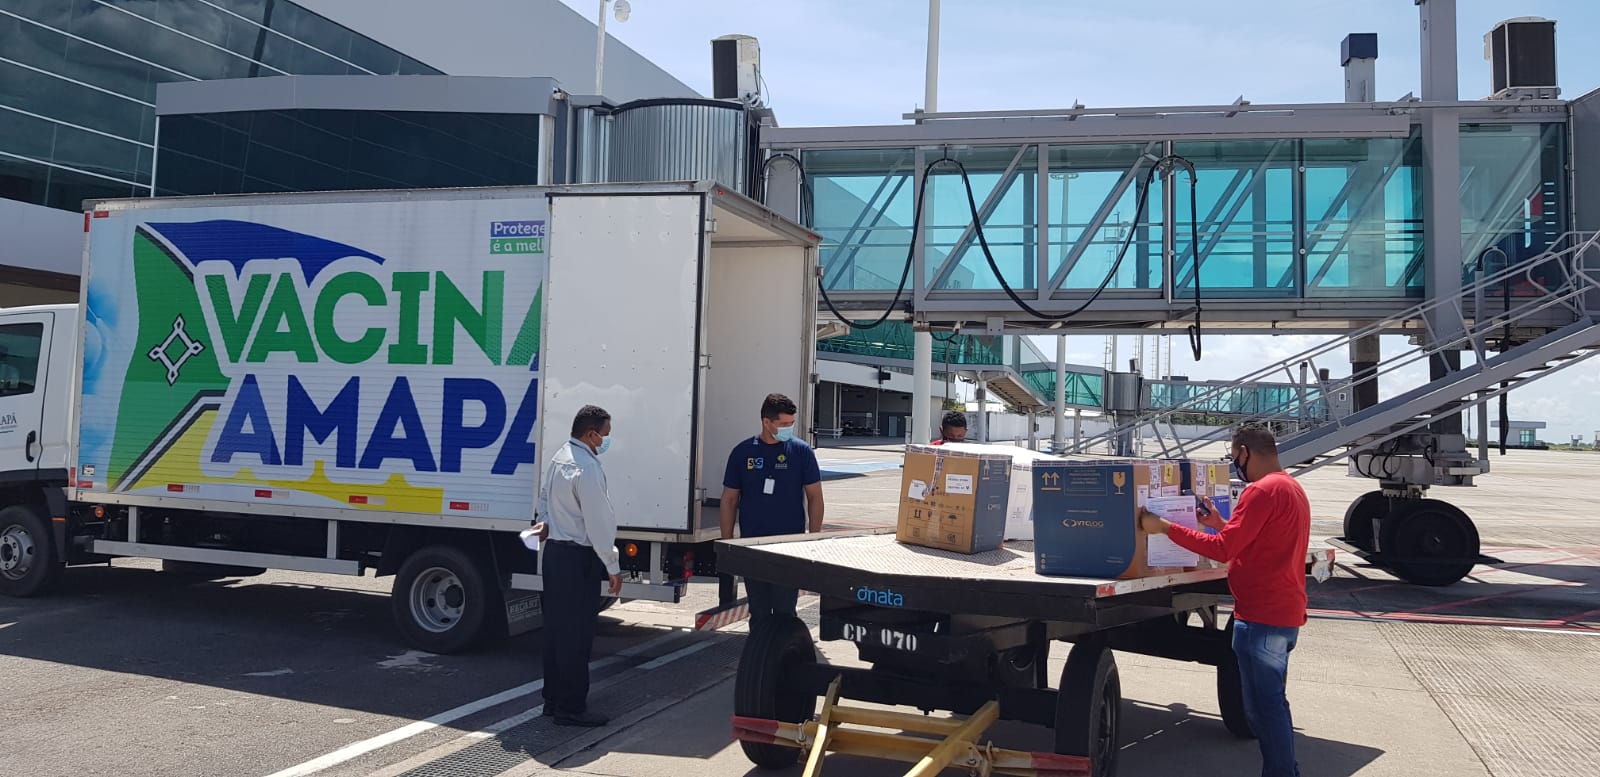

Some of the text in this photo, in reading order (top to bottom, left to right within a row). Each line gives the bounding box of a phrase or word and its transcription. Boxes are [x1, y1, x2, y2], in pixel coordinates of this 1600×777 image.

[493, 240, 501, 252] é
[504, 242, 512, 252] a
[0, 412, 17, 425] APÁ
[857, 586, 903, 606] dnata
[843, 623, 917, 651] CP 070
